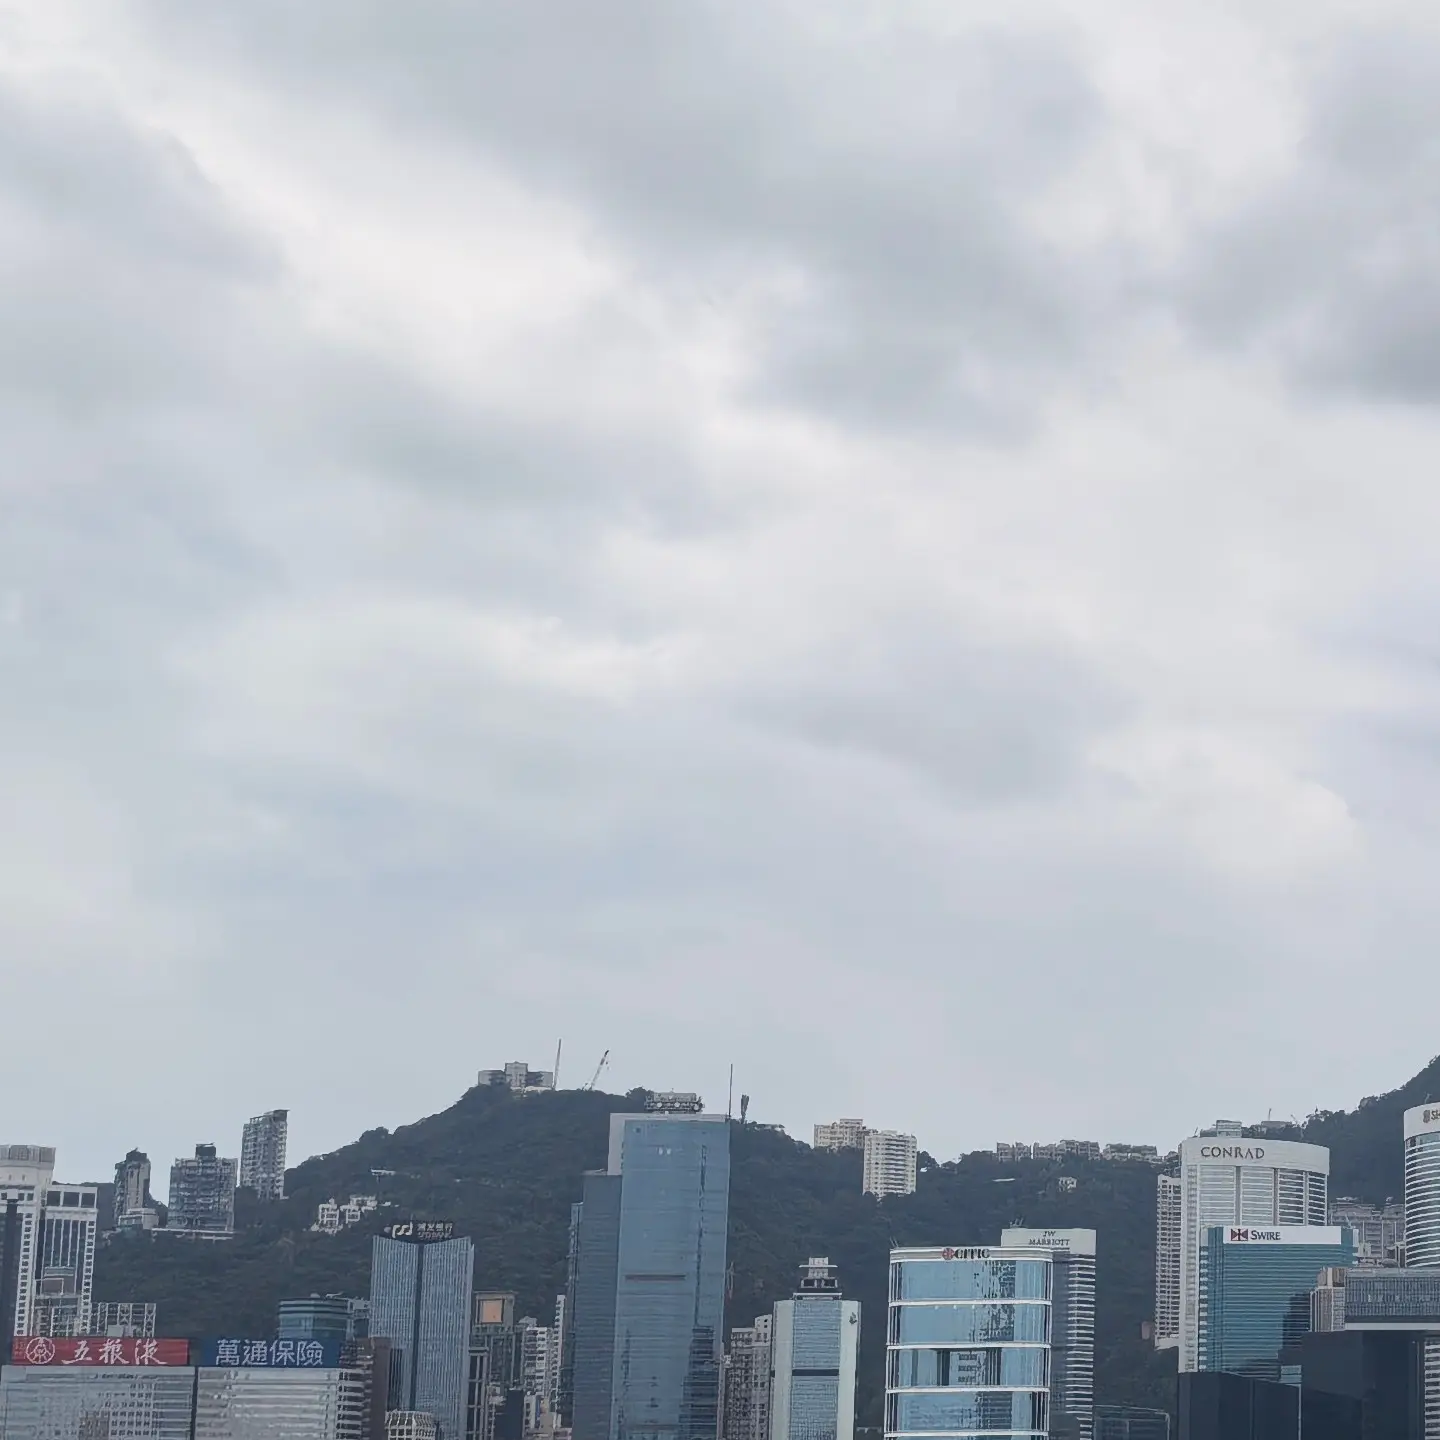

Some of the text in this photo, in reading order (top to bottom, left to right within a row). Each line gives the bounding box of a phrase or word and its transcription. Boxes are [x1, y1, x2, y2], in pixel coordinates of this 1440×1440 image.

[1200, 1146, 1265, 1159] CONRAD
[1028, 1238, 1070, 1246] MARRIOTT
[954, 1248, 990, 1259] CITIC
[61, 1338, 168, 1365] 五粮液
[215, 1339, 324, 1366] 萬通保險
